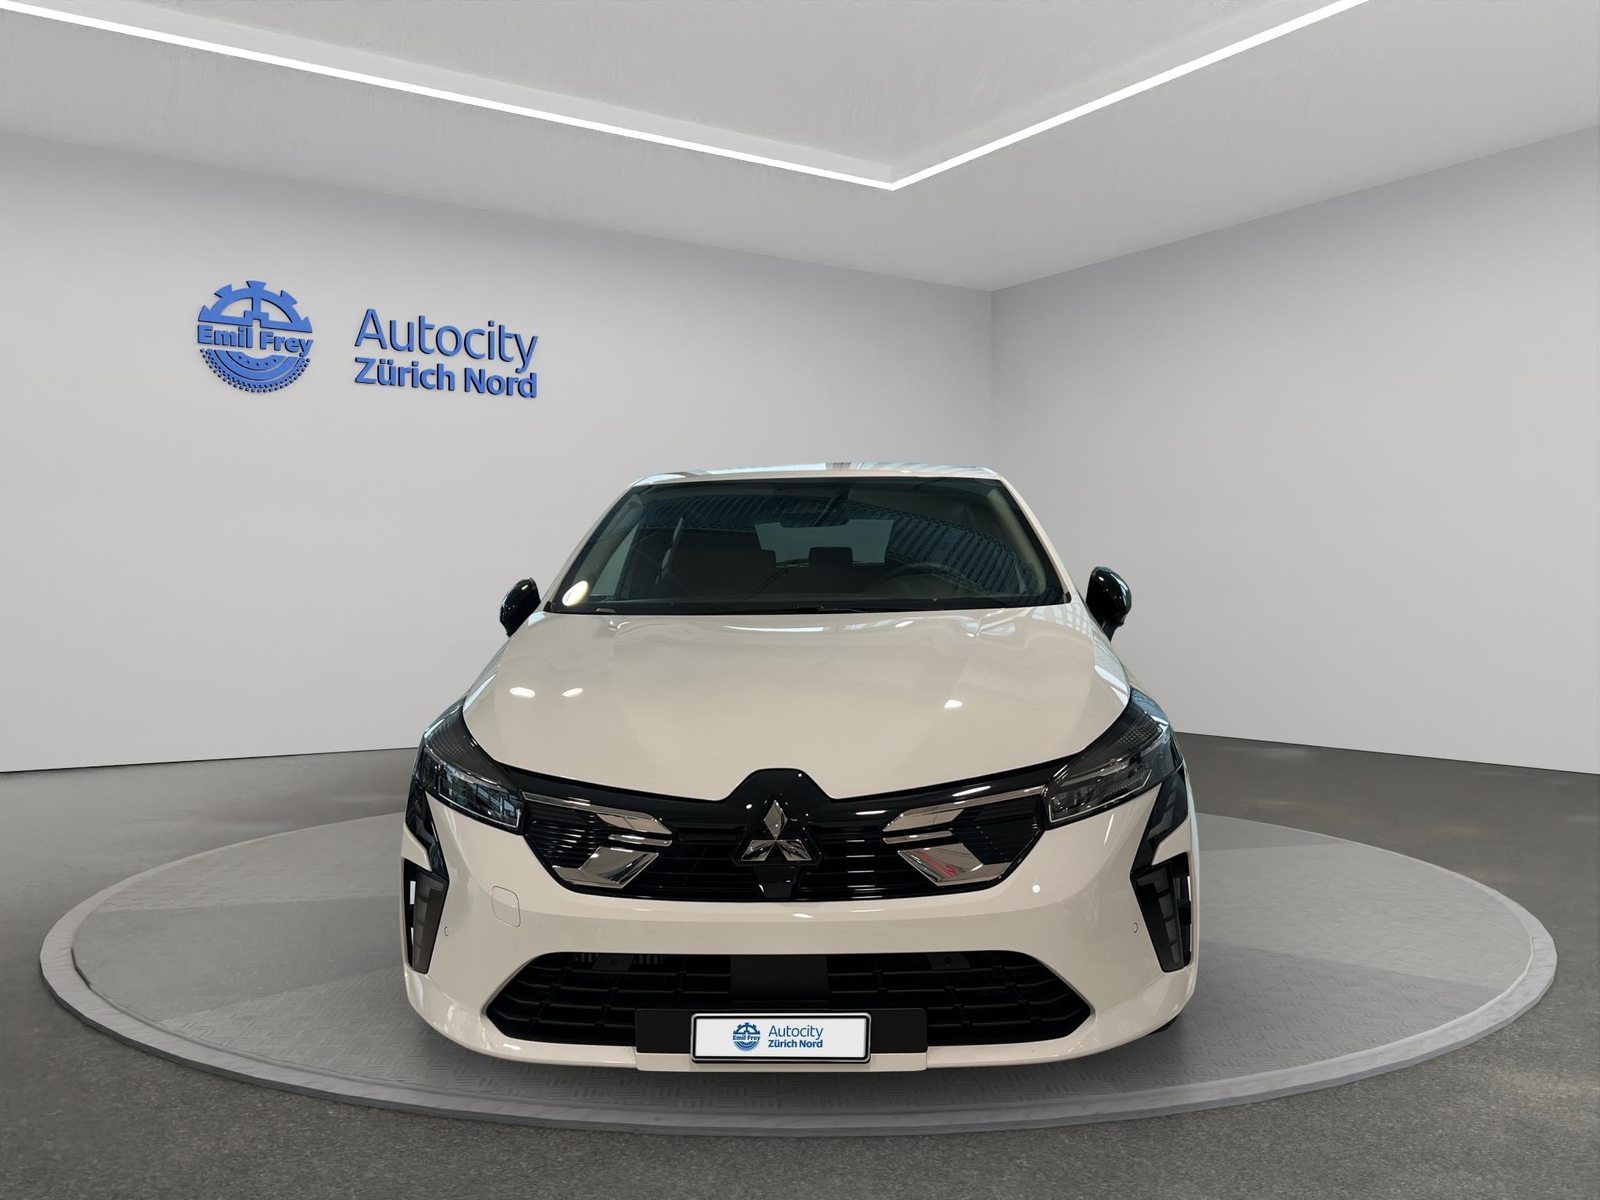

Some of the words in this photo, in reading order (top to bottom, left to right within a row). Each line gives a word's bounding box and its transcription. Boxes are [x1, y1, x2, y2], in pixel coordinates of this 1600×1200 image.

[197, 324, 254, 349] Emil
[260, 332, 314, 357] Frey
[355, 308, 539, 374] Autocity
[355, 356, 456, 392] Zürich
[465, 367, 538, 398] Nord
[747, 1034, 761, 1042] Frey
[768, 1025, 824, 1040] Autocity
[768, 1039, 798, 1048] Zürich
[799, 1039, 823, 1048] Nord
